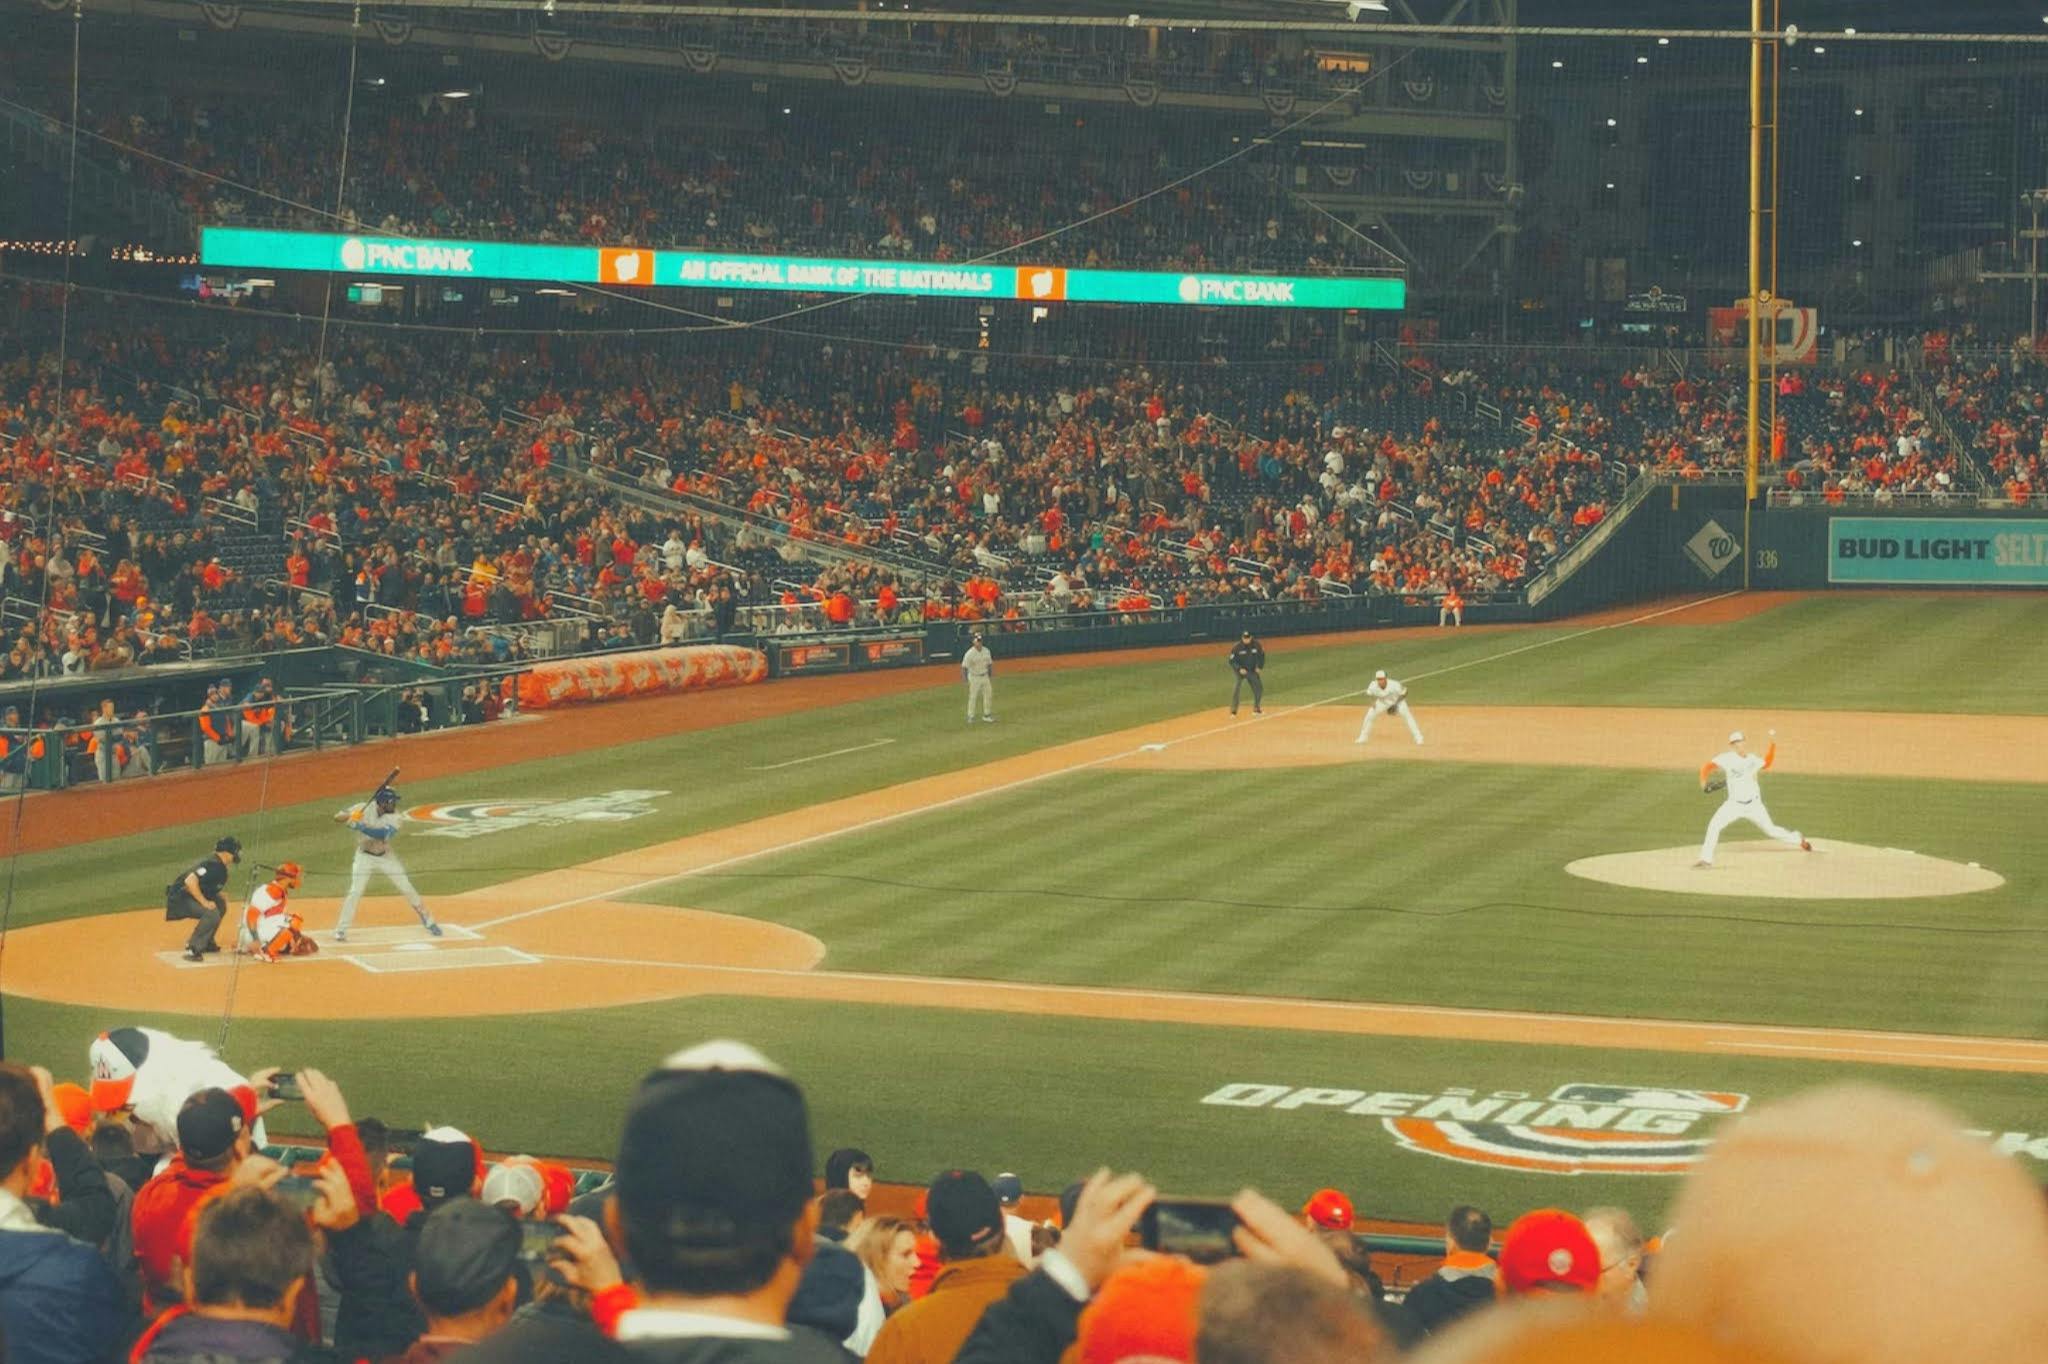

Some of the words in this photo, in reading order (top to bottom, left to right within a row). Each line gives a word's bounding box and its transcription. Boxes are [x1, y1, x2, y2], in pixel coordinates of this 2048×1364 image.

[367, 244, 415, 269] PNC
[416, 246, 473, 272] BANK
[680, 260, 706, 280] AN
[709, 261, 785, 283] OFFICIAL
[788, 264, 834, 286] BANK
[837, 267, 859, 286] OF
[863, 268, 896, 288] THE
[900, 270, 992, 291] NATIONALS
[1202, 280, 1242, 300] PNC
[1243, 281, 1295, 302] BANK
[1838, 538, 1900, 559] BUD
[1904, 539, 1990, 560] LIGHT
[1994, 533, 2048, 566] SELT
[1201, 1083, 1700, 1134] OPENING
